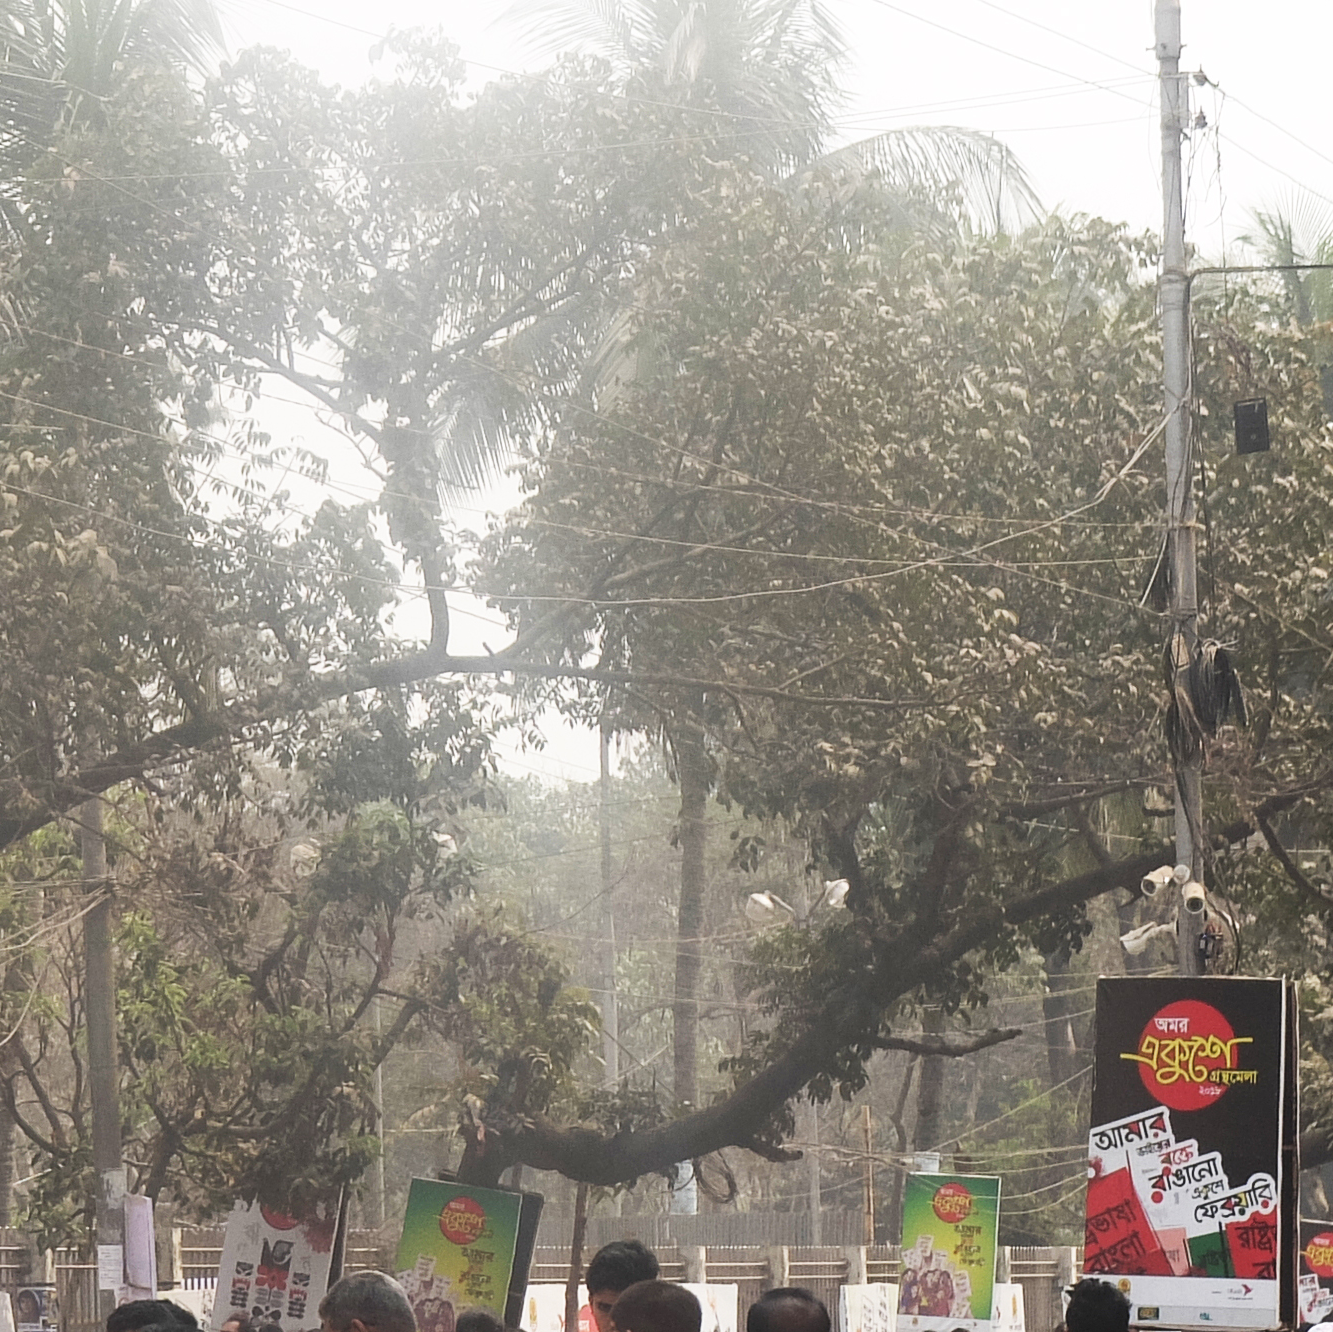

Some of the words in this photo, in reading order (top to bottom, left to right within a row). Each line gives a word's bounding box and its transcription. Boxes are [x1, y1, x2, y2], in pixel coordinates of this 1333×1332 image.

[1154, 1017, 1190, 1034] অমর
[1120, 1034, 1254, 1085] একুশে
[1092, 1112, 1169, 1151] আমার
